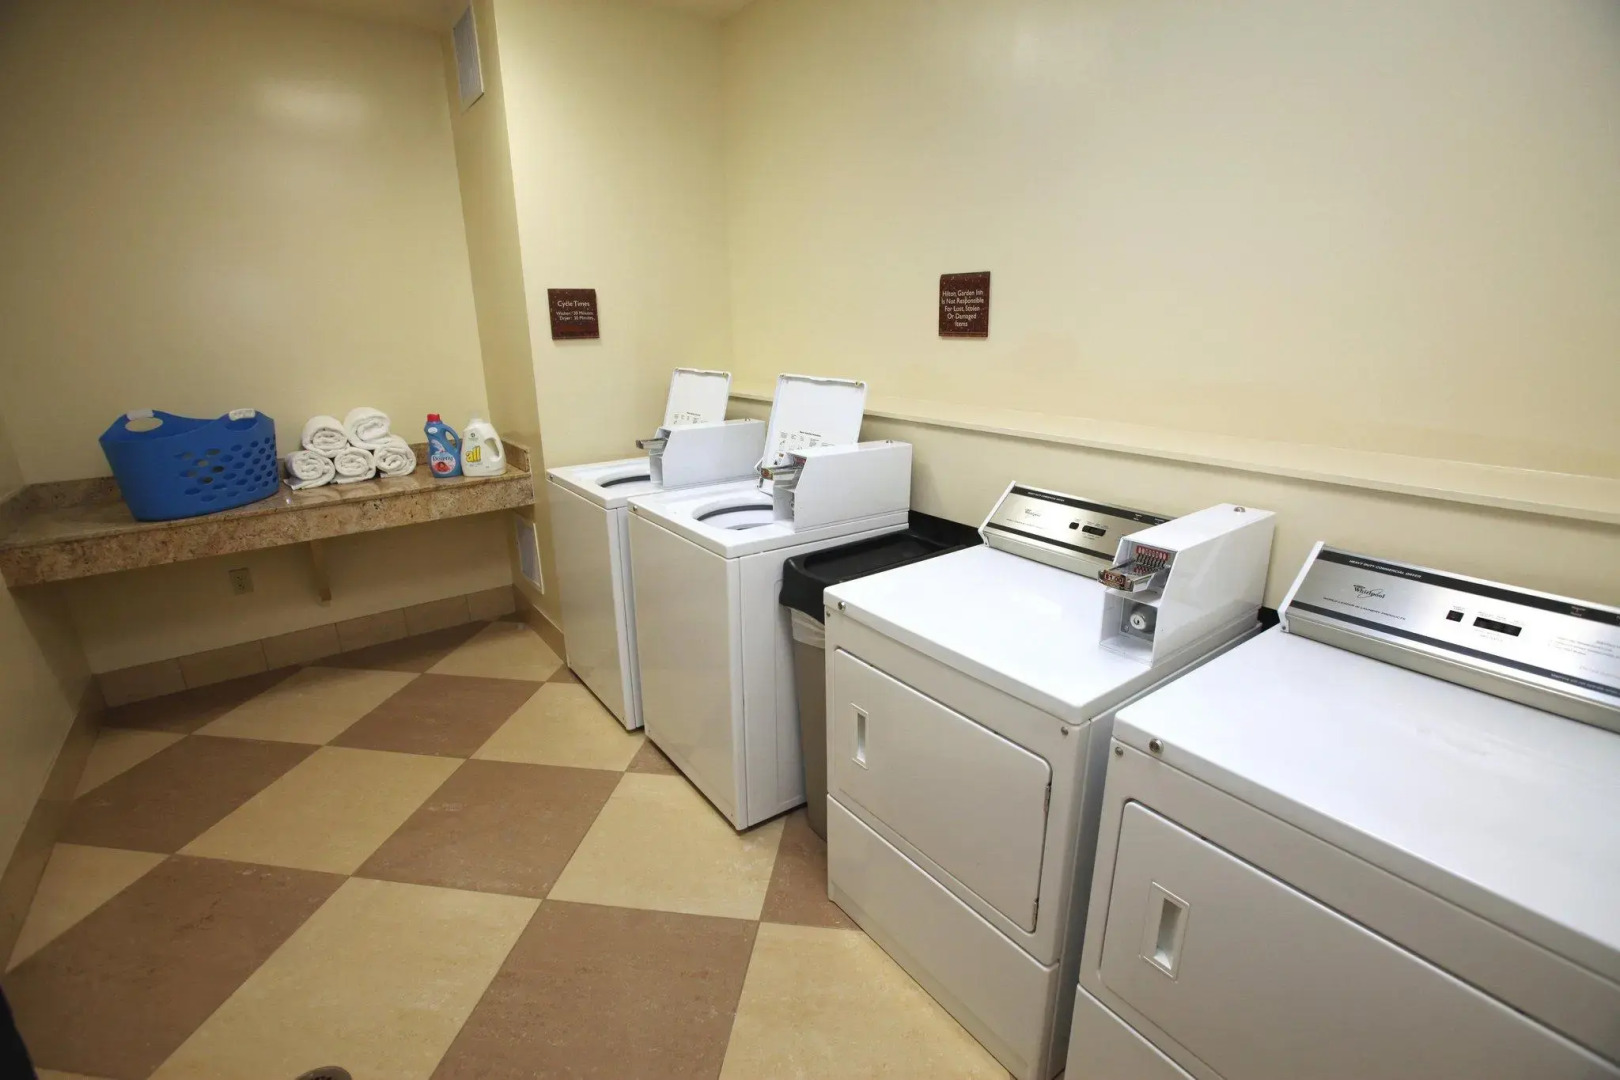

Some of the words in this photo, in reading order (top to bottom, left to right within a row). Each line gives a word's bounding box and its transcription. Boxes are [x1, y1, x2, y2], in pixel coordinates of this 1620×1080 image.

[557, 300, 573, 308] Cycle
[466, 445, 481, 462] all
[1354, 587, 1386, 599] Whirlpool
